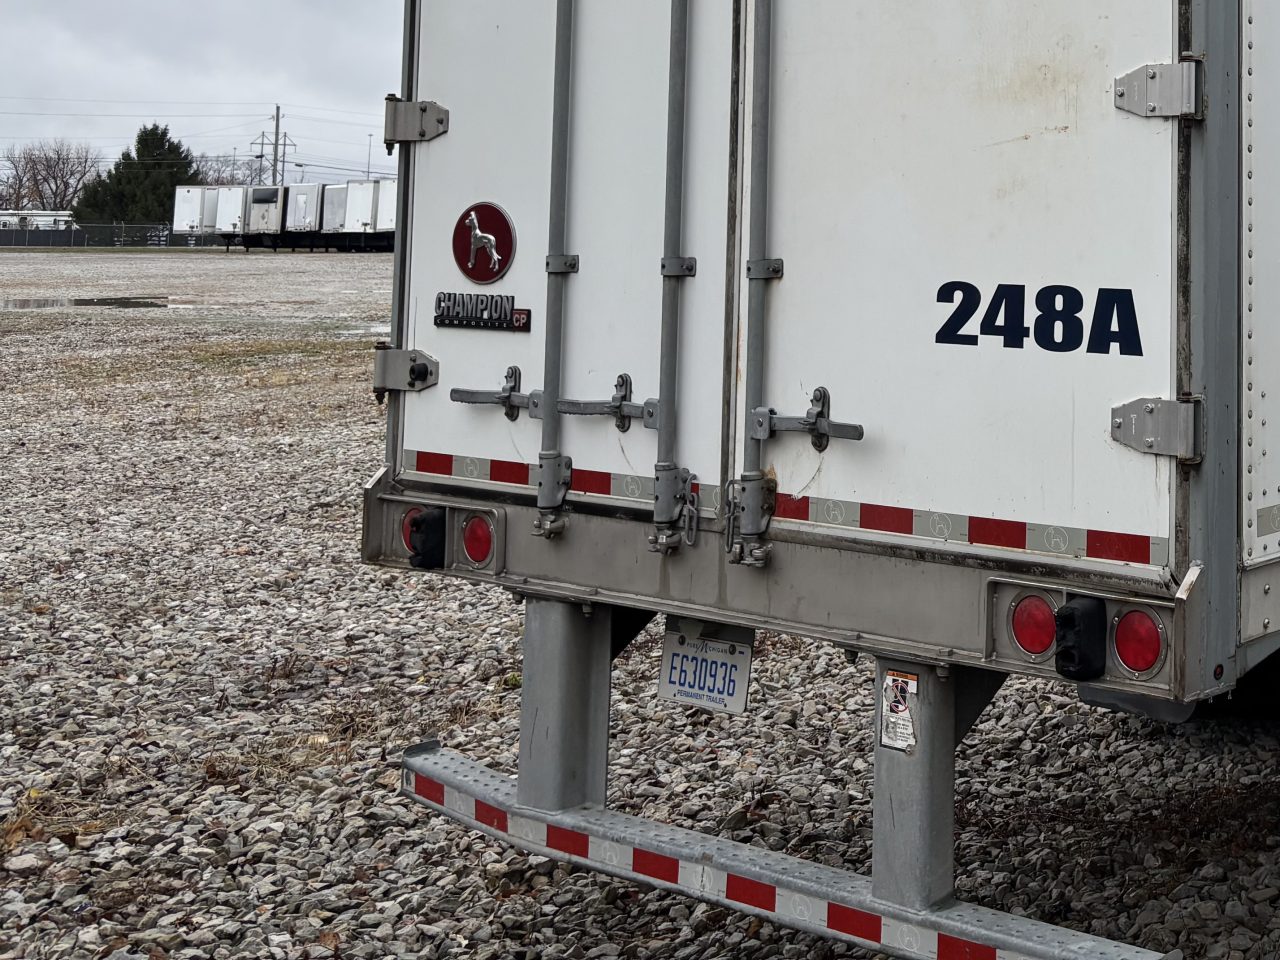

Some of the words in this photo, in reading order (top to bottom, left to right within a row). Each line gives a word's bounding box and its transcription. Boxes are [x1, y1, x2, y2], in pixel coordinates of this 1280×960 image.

[435, 292, 515, 320] CHAMPION
[437, 319, 507, 328] COMPOSITE
[513, 314, 527, 327] CP
[935, 281, 1143, 356] 248A
[669, 652, 738, 697] E630936
[677, 689, 705, 700] PERMANENT
[706, 695, 725, 705] TRAILER
